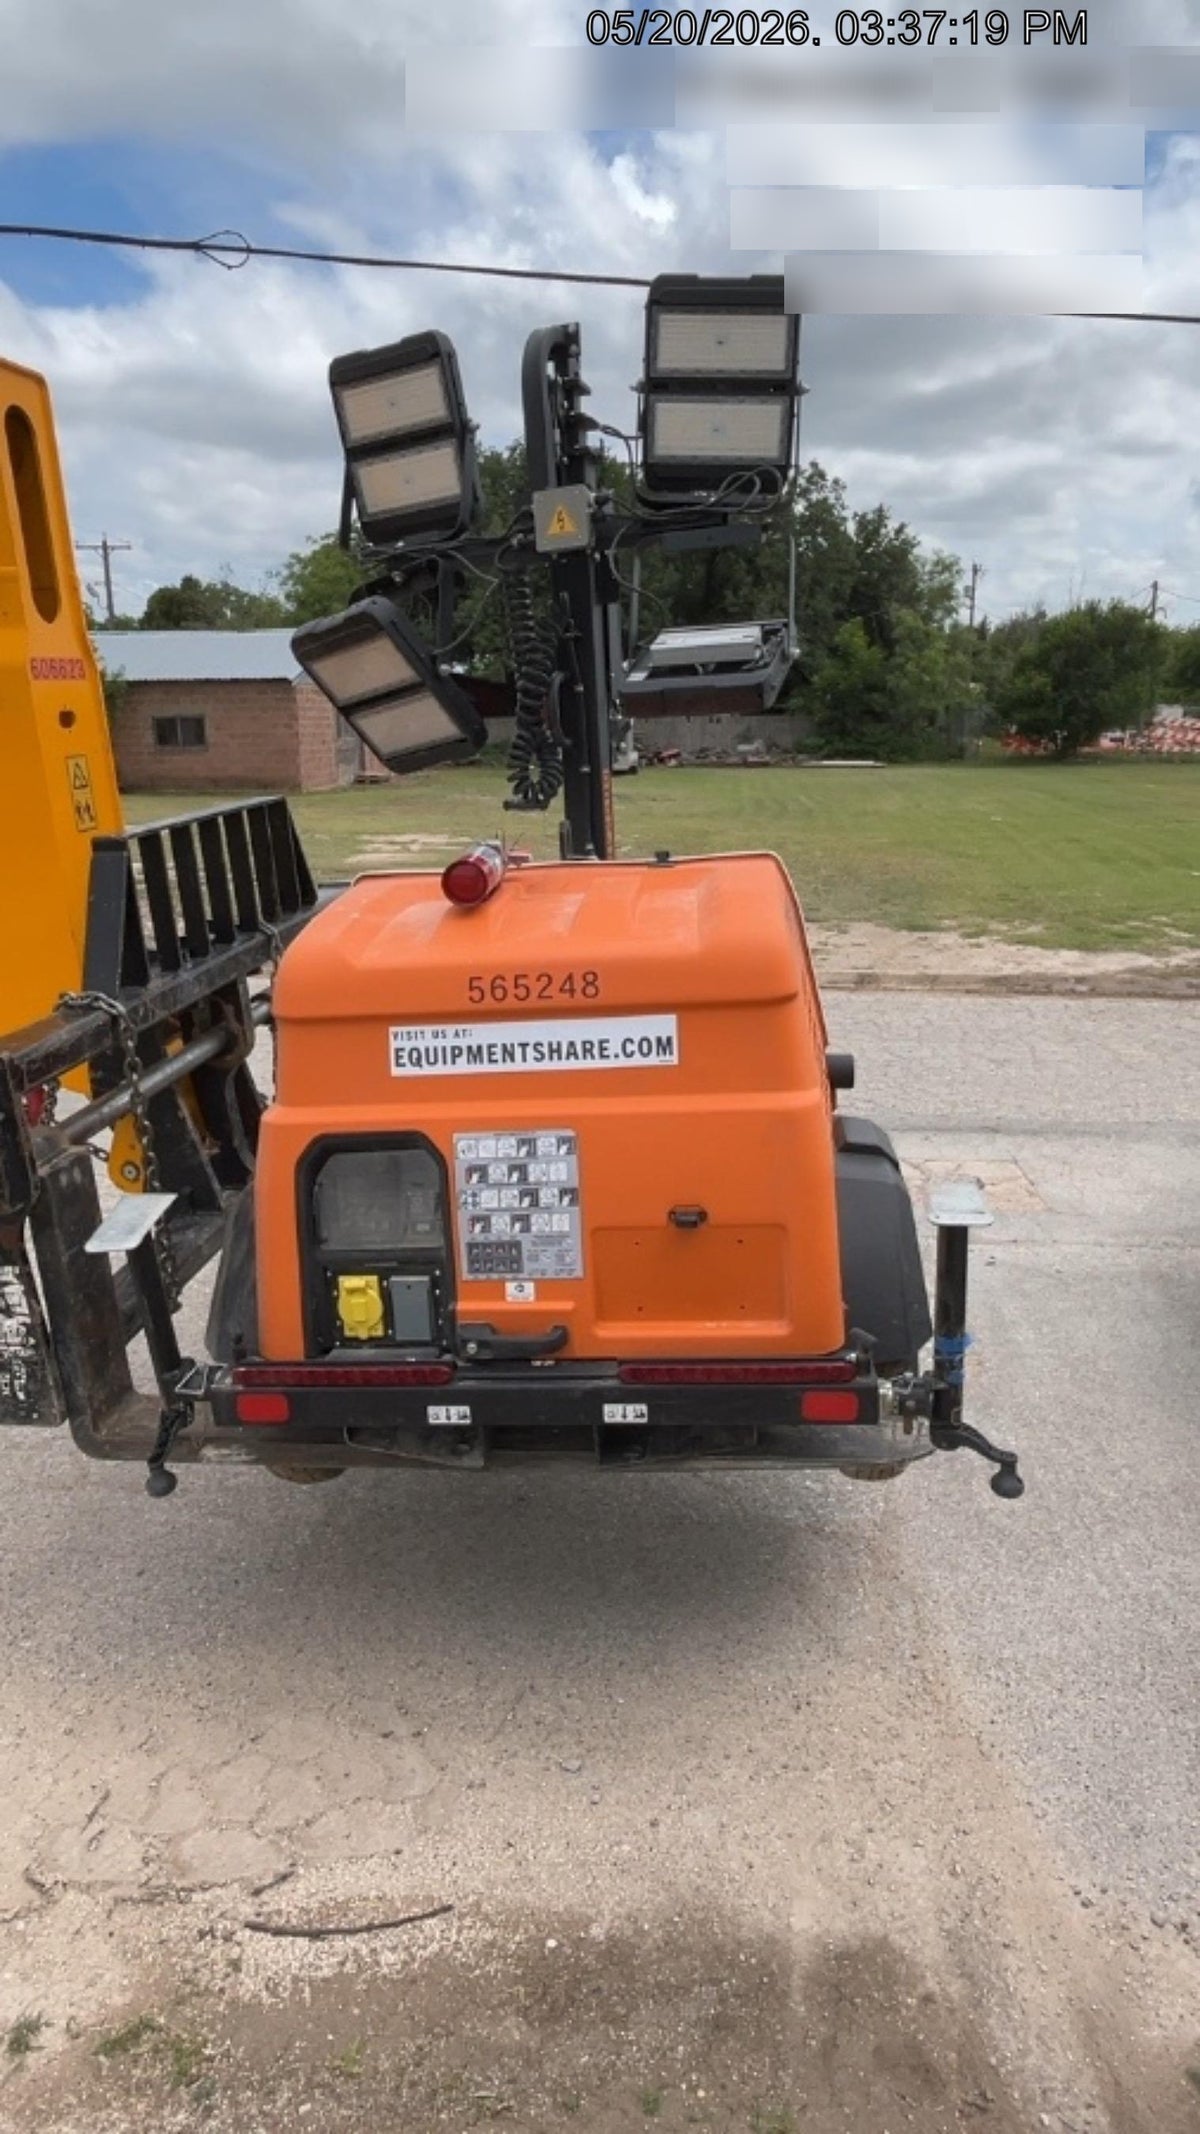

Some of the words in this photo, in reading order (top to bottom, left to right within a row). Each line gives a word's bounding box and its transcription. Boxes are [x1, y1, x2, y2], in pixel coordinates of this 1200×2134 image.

[468, 971, 600, 1003] 565248
[393, 1031, 425, 1041] VISIT
[431, 1030, 447, 1039] US
[394, 1036, 674, 1068] EQUIPMENTSHARE.COM
